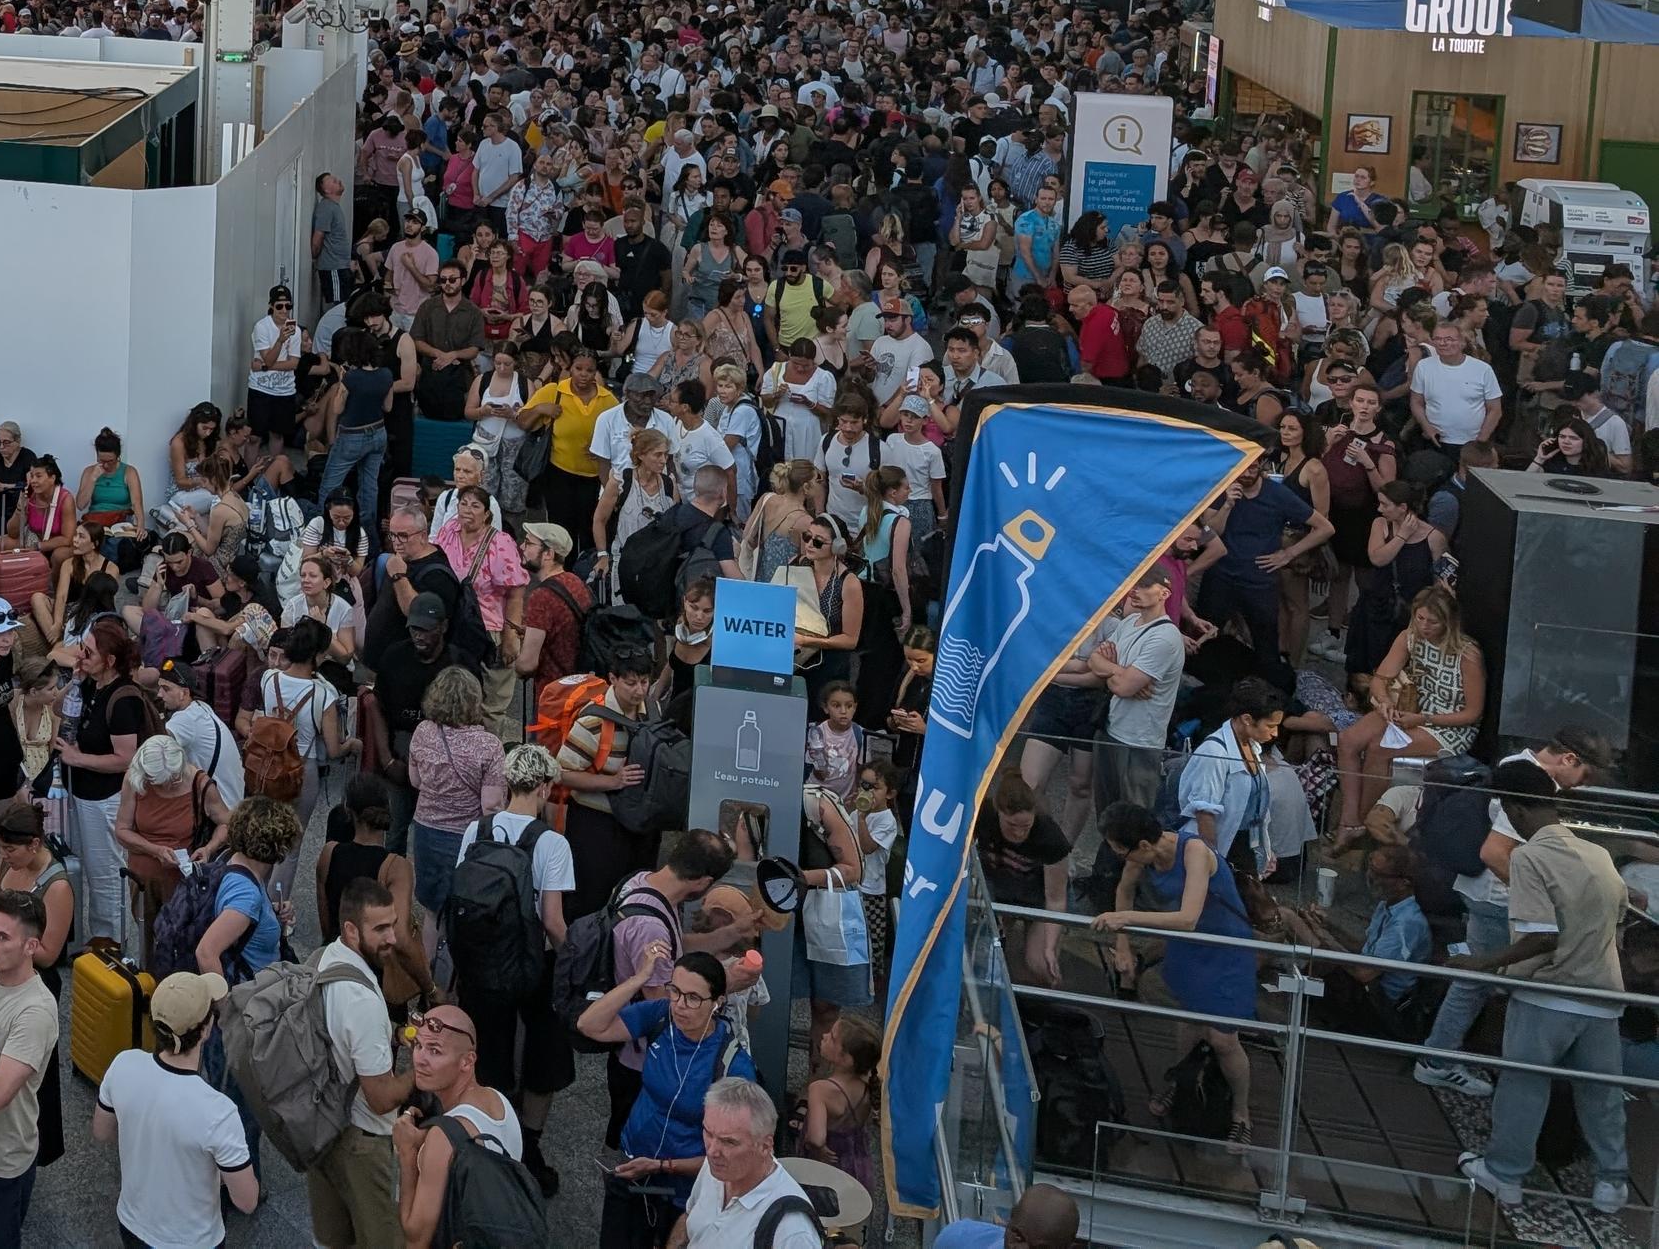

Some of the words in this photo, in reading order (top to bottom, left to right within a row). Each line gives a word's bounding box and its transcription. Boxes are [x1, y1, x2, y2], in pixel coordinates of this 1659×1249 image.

[1432, 37, 1445, 52] LA
[1448, 38, 1486, 54] TOURTE
[1098, 178, 1117, 187] plan
[1098, 204, 1145, 212] commerces
[723, 616, 787, 638] WATER
[714, 771, 739, 782] L'eau
[741, 776, 780, 788] potable
